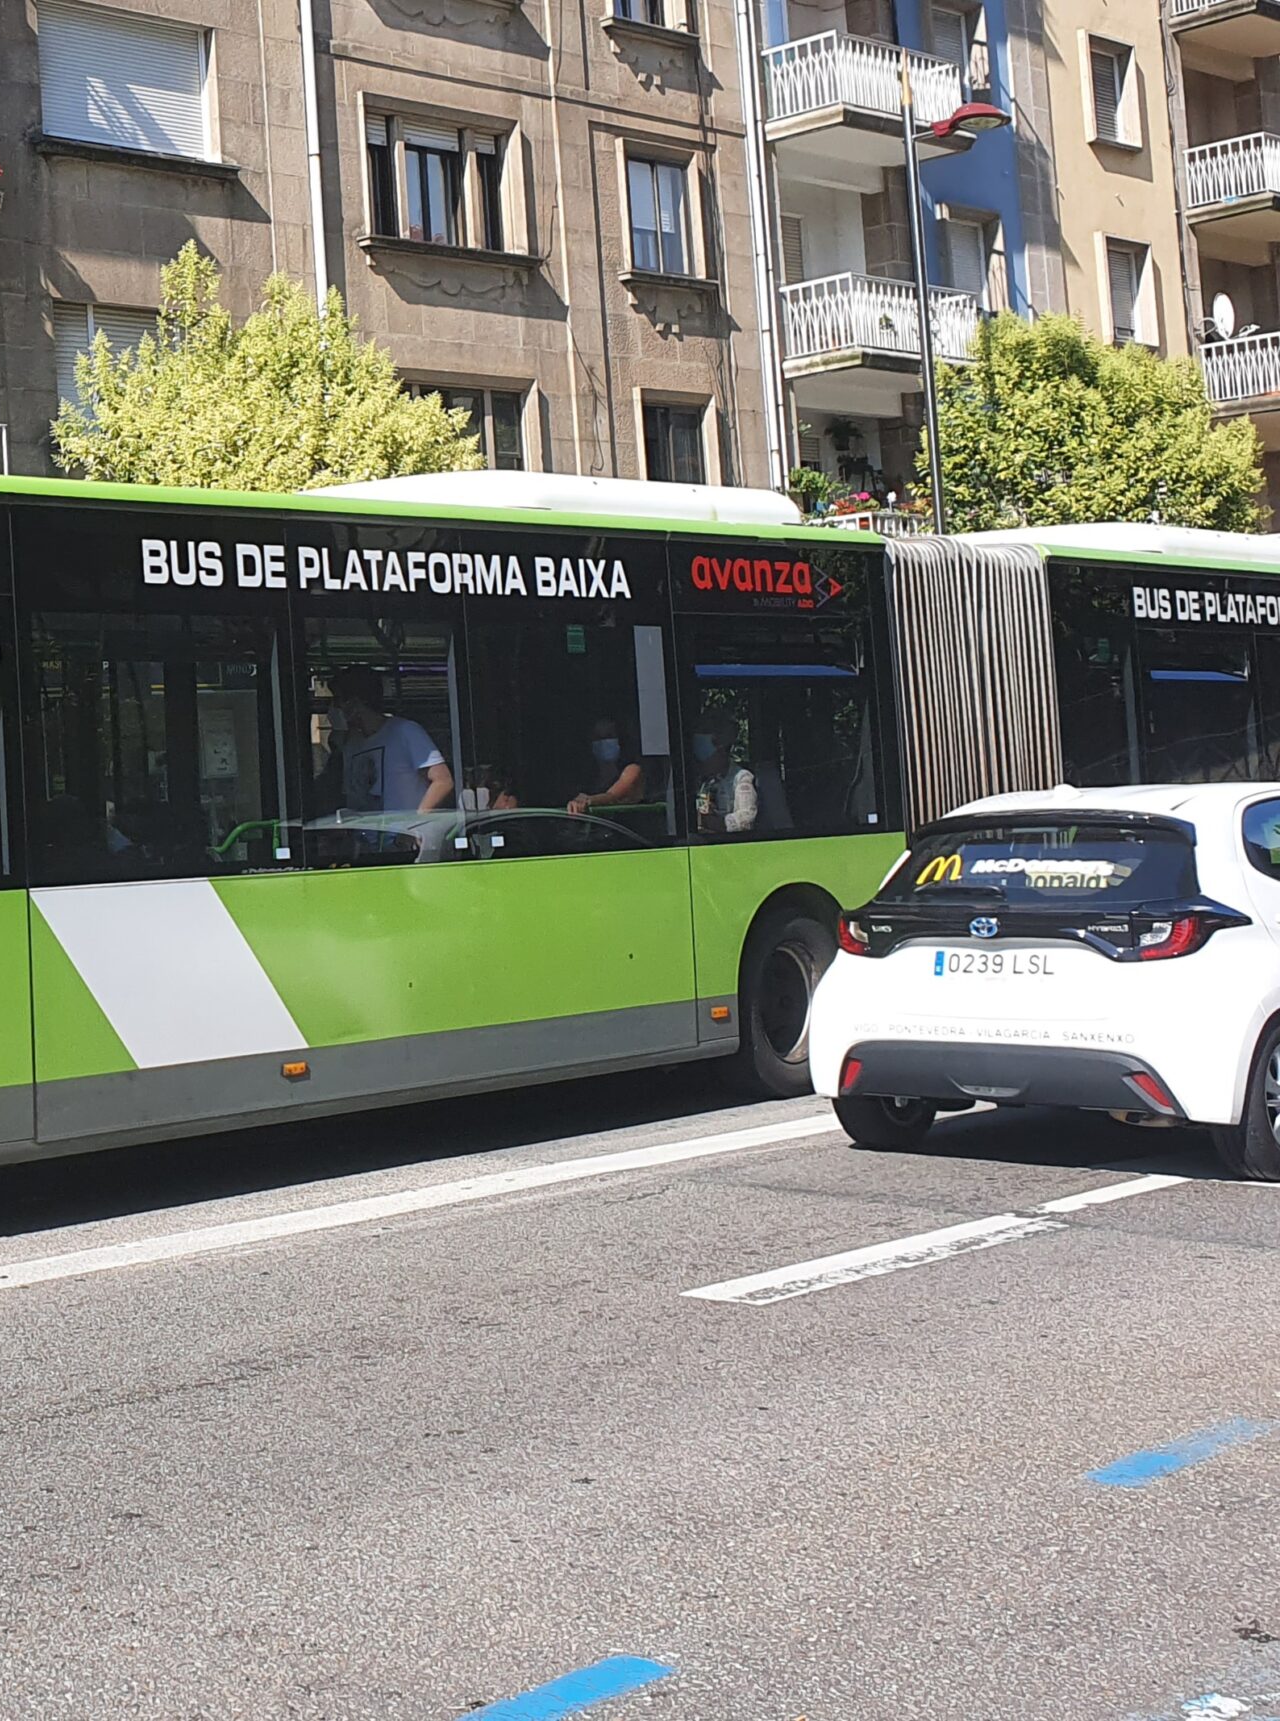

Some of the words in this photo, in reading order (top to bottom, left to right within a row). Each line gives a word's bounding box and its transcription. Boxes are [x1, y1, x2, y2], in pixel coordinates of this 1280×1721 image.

[141, 538, 224, 587] BUS
[235, 543, 288, 588] DE
[297, 546, 528, 597] PLATAFORMA
[534, 556, 632, 600] BAIXA
[691, 555, 812, 595] avanza
[1132, 586, 1172, 620] BUS
[1175, 589, 1201, 621] DE
[1204, 591, 1280, 626] PLATAFO
[948, 953, 1004, 974] 0239
[1013, 953, 1055, 975] LSL
[888, 1024, 966, 1036] PONTEVEDRA
[1062, 1031, 1135, 1044] SANXENXO
